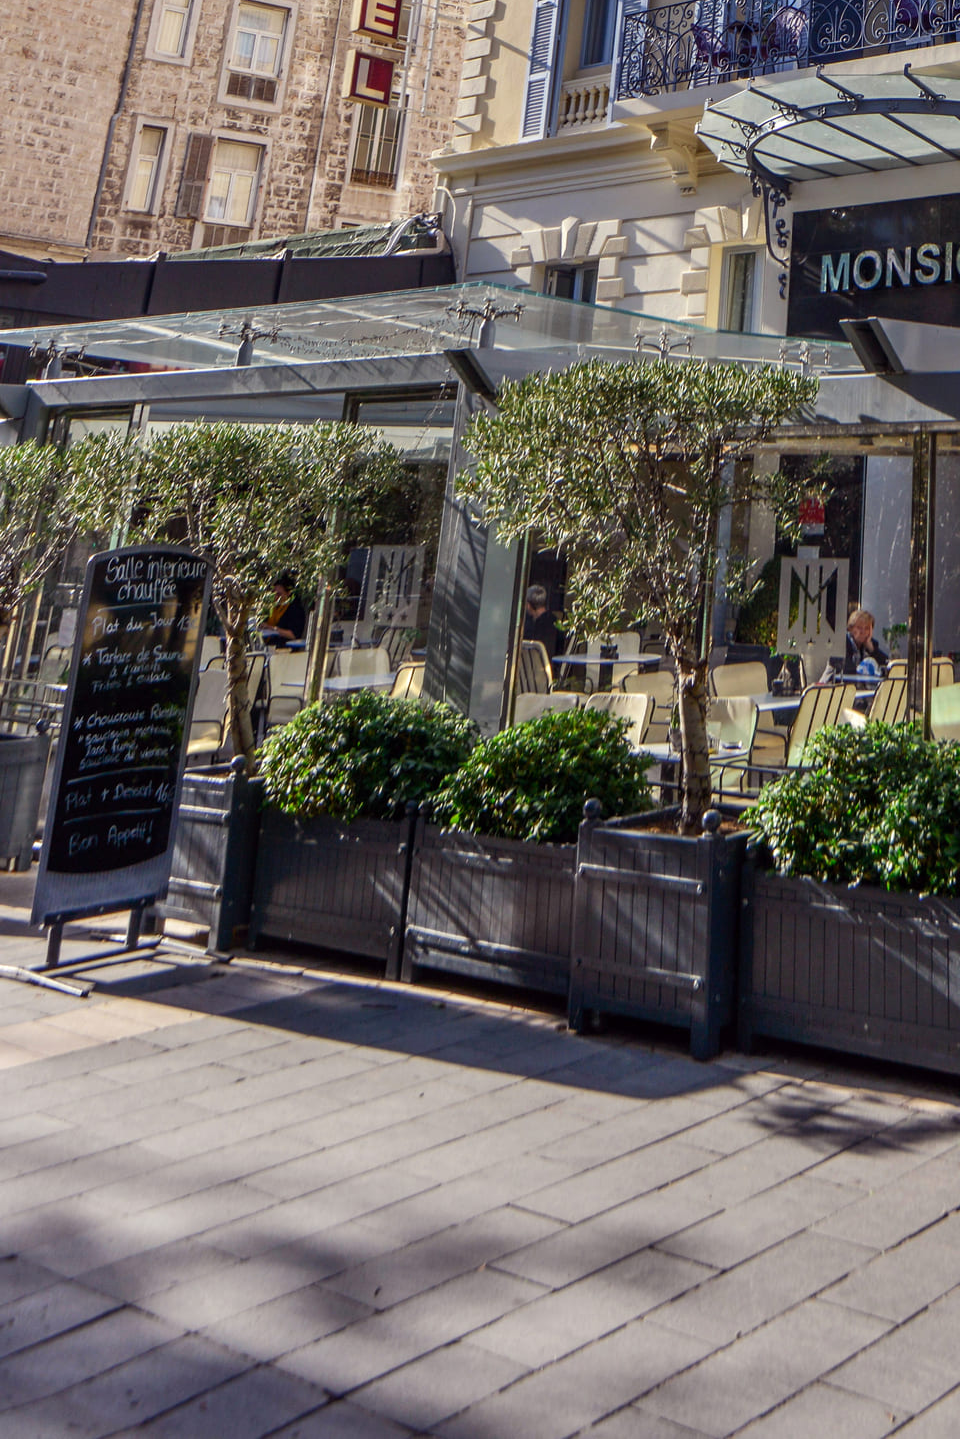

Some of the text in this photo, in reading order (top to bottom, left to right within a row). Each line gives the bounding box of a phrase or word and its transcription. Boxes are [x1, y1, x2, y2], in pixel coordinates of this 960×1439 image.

[105, 556, 144, 584] Salle
[117, 578, 177, 604] chauffée
[92, 615, 119, 637] Plat
[126, 616, 143, 632] du
[149, 611, 175, 631] Jour
[96, 646, 132, 665] Tartare
[136, 645, 150, 663] de
[86, 711, 145, 729] Choucroute
[65, 786, 92, 811] Plat
[68, 833, 99, 857] Bon
